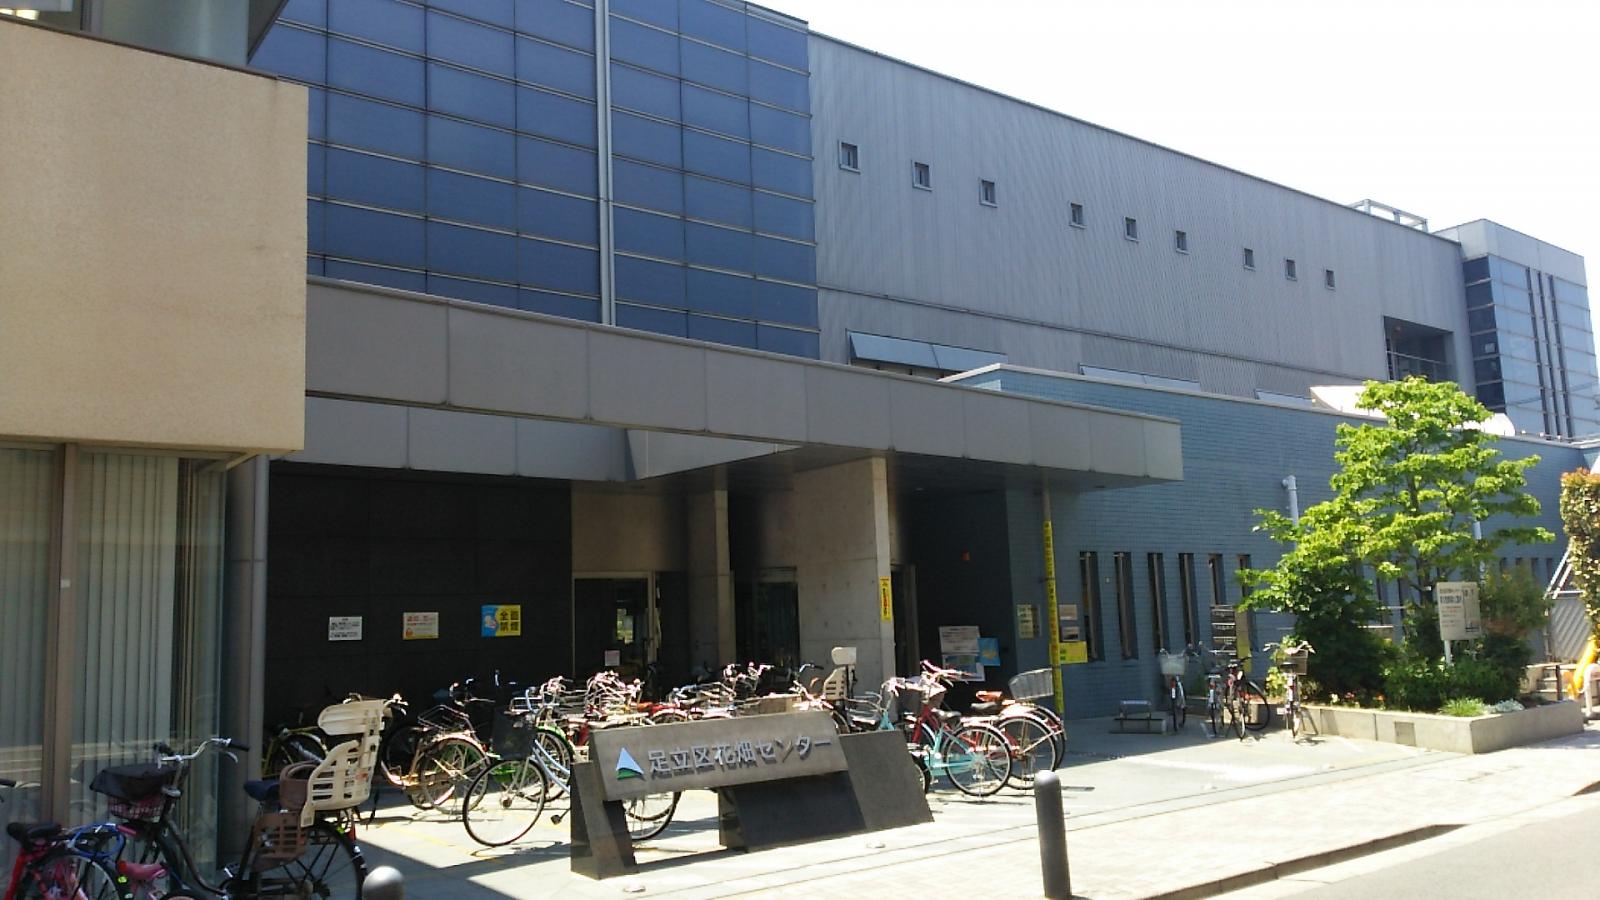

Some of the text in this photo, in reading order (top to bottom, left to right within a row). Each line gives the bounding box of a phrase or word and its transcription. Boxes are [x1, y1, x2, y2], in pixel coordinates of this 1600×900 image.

[648, 735, 832, 772] 足立区花畑センター
